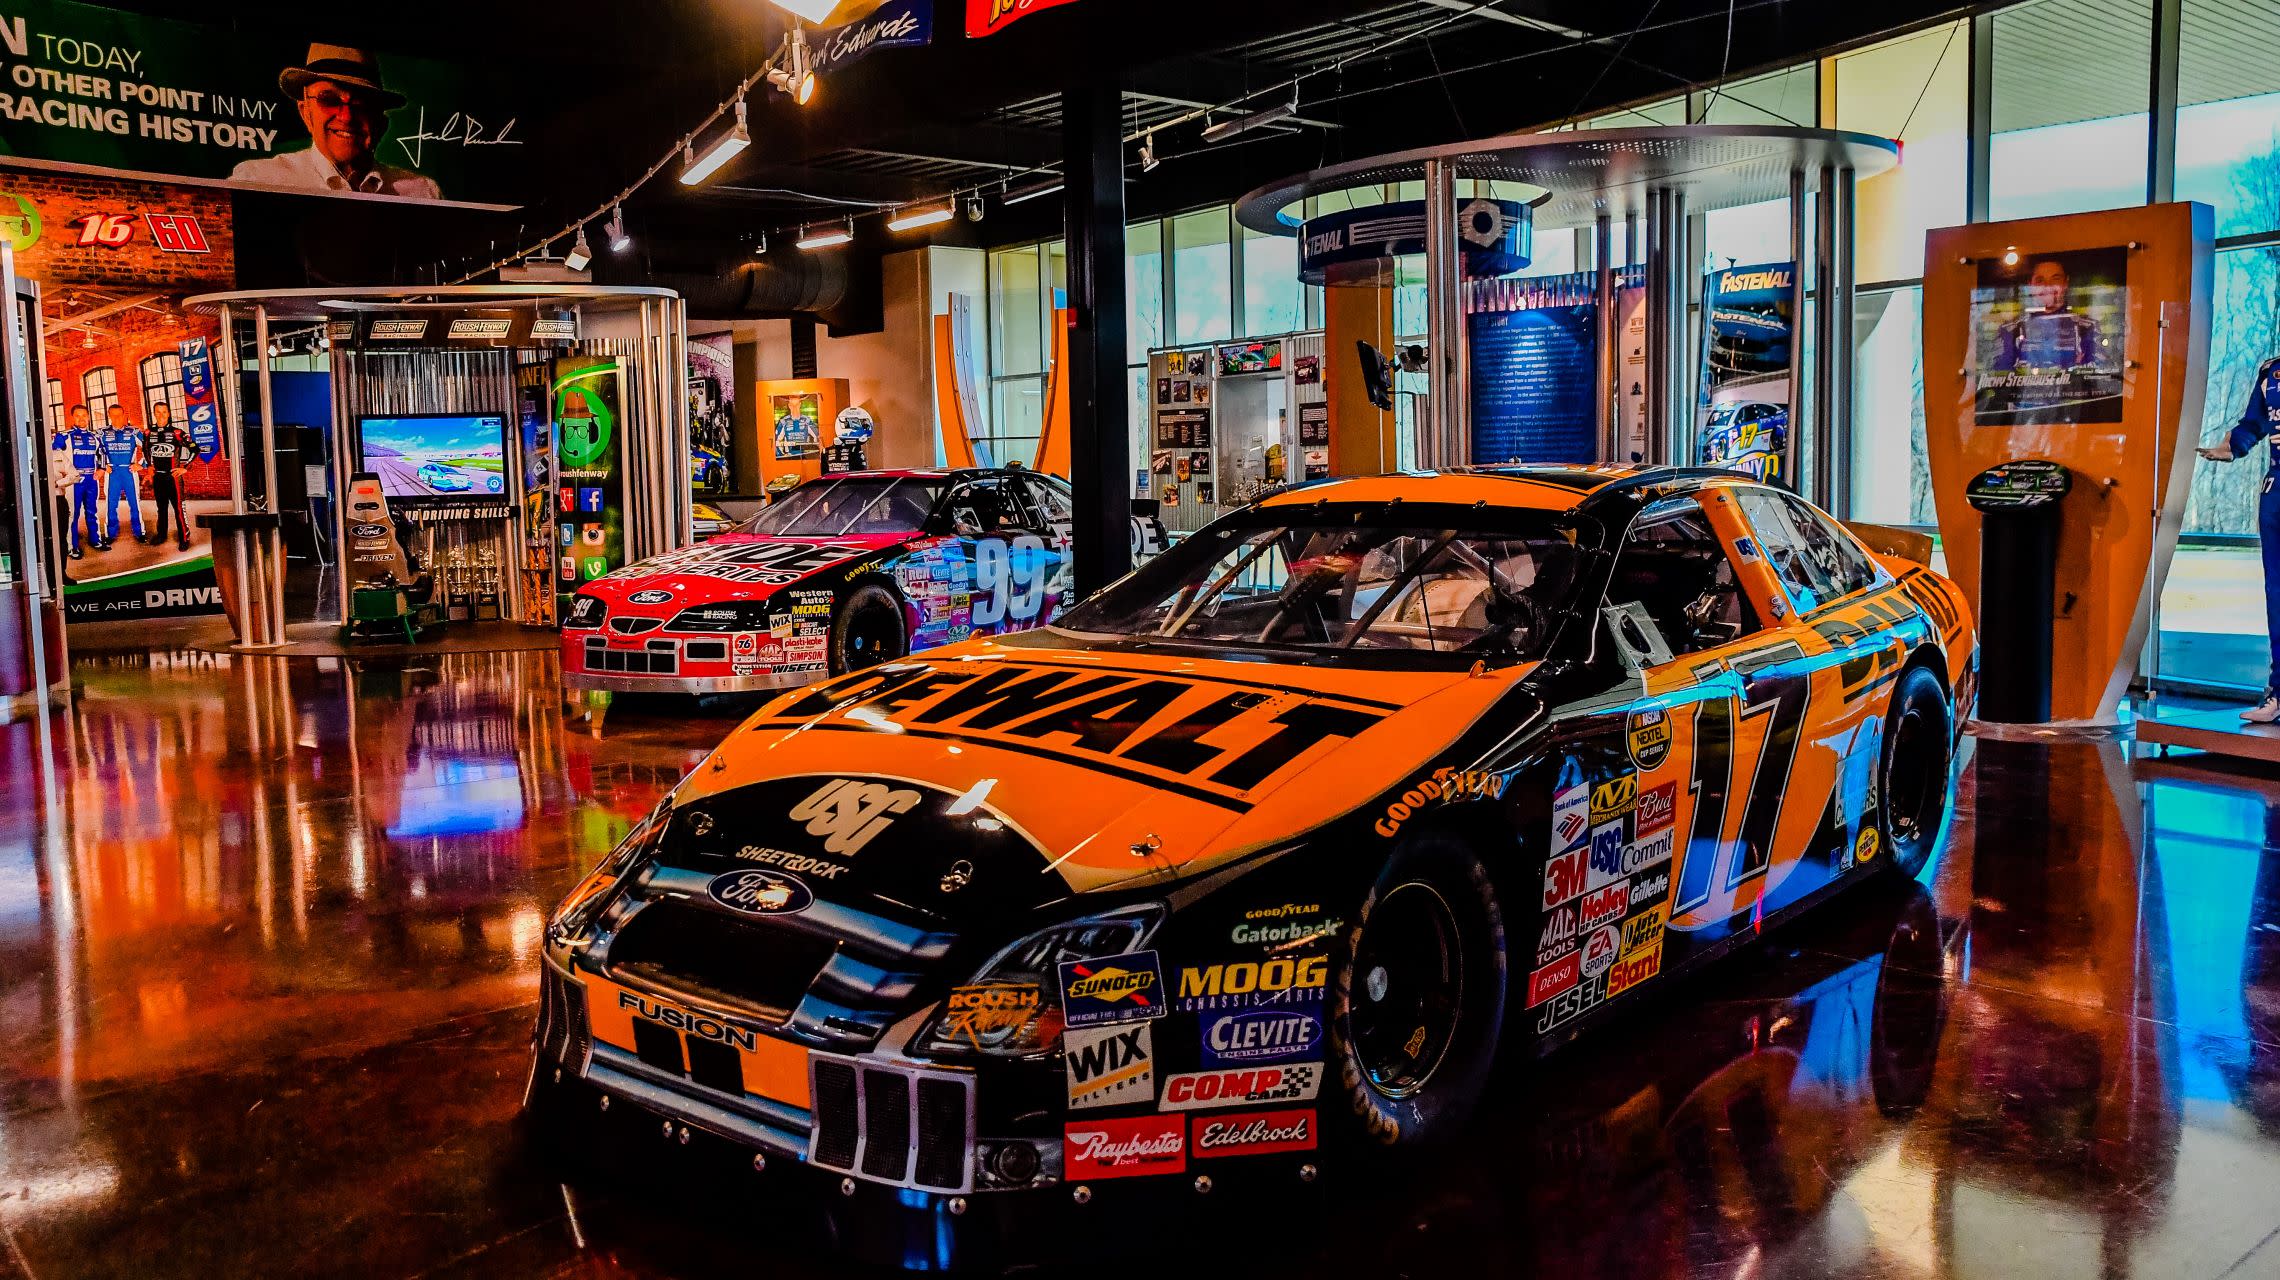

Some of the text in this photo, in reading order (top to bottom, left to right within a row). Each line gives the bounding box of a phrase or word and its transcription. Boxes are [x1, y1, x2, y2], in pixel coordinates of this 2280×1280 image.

[831, 10, 920, 61] Edwards
[37, 33, 144, 79] TODAY,
[12, 65, 278, 121] OTHER POINT IN MY
[139, 112, 278, 152] HISTORY
[77, 211, 138, 247] 16
[145, 213, 211, 252] 60
[1720, 271, 1792, 294] FASTENAL
[453, 321, 508, 333] ROUSH FENWAY
[183, 341, 203, 358] 17
[191, 404, 212, 422] 6
[1738, 422, 1758, 450] 17
[422, 506, 511, 520] DRIVING SKILLS
[357, 526, 381, 536] Ford
[789, 590, 834, 598] Western
[971, 535, 1046, 626] 99
[70, 603, 100, 613] WE
[105, 600, 142, 611] ARE
[573, 599, 594, 616] 99
[634, 591, 666, 602] Ford
[792, 605, 831, 615] MOOG
[771, 615, 791, 629] WIX
[800, 627, 827, 636] SELECT
[738, 639, 751, 649] 76
[789, 651, 823, 662] SIMPSON
[771, 663, 826, 674] WISECO
[776, 665, 1389, 792] DEWALT
[1642, 710, 1661, 726] NASCAR
[1636, 727, 1665, 747] NEXTEL
[1640, 745, 1664, 759] CUP SERIES
[1671, 638, 1812, 921] 17
[1375, 765, 1503, 838] GOODYEAR
[1554, 802, 1566, 813] Bank
[1571, 795, 1588, 807] America
[1638, 786, 1675, 821] Bud
[789, 778, 922, 857] USG
[735, 845, 838, 880] SHEETROCK
[1589, 826, 1622, 876] USG
[1621, 829, 1674, 875] Commit
[1545, 847, 1590, 906] 3M
[1630, 874, 1668, 906] Gillette
[1245, 903, 1320, 919] GOODYEAR
[1581, 884, 1629, 924] Holley
[1231, 919, 1338, 944] Gatorback
[1538, 907, 1576, 952] MAC
[1580, 910, 1618, 932] HP CARBS
[1634, 911, 1659, 933] Auto
[1536, 938, 1575, 966] TOOLS
[1587, 929, 1613, 961] EA
[1585, 951, 1613, 974] SPORTS
[1608, 945, 1660, 995] Stant
[1072, 973, 1152, 996] SUNOCO
[1178, 956, 1329, 998] MOOG
[1539, 965, 1571, 992] DENSO
[948, 991, 1039, 1008] ROUSH
[1186, 987, 1325, 1012] CHASSIS PARTS
[1537, 974, 1606, 1035] JESEL
[618, 990, 758, 1054] FUSION
[1210, 1015, 1315, 1051] CLEVITE
[1067, 1025, 1149, 1084] WIX
[1071, 1071, 1150, 1107] FILTERS
[1167, 1069, 1283, 1103] COMP
[1245, 1087, 1301, 1102] CAMS
[1200, 1116, 1308, 1149] Edelbrock
[1067, 1131, 1184, 1166] Raybestos
